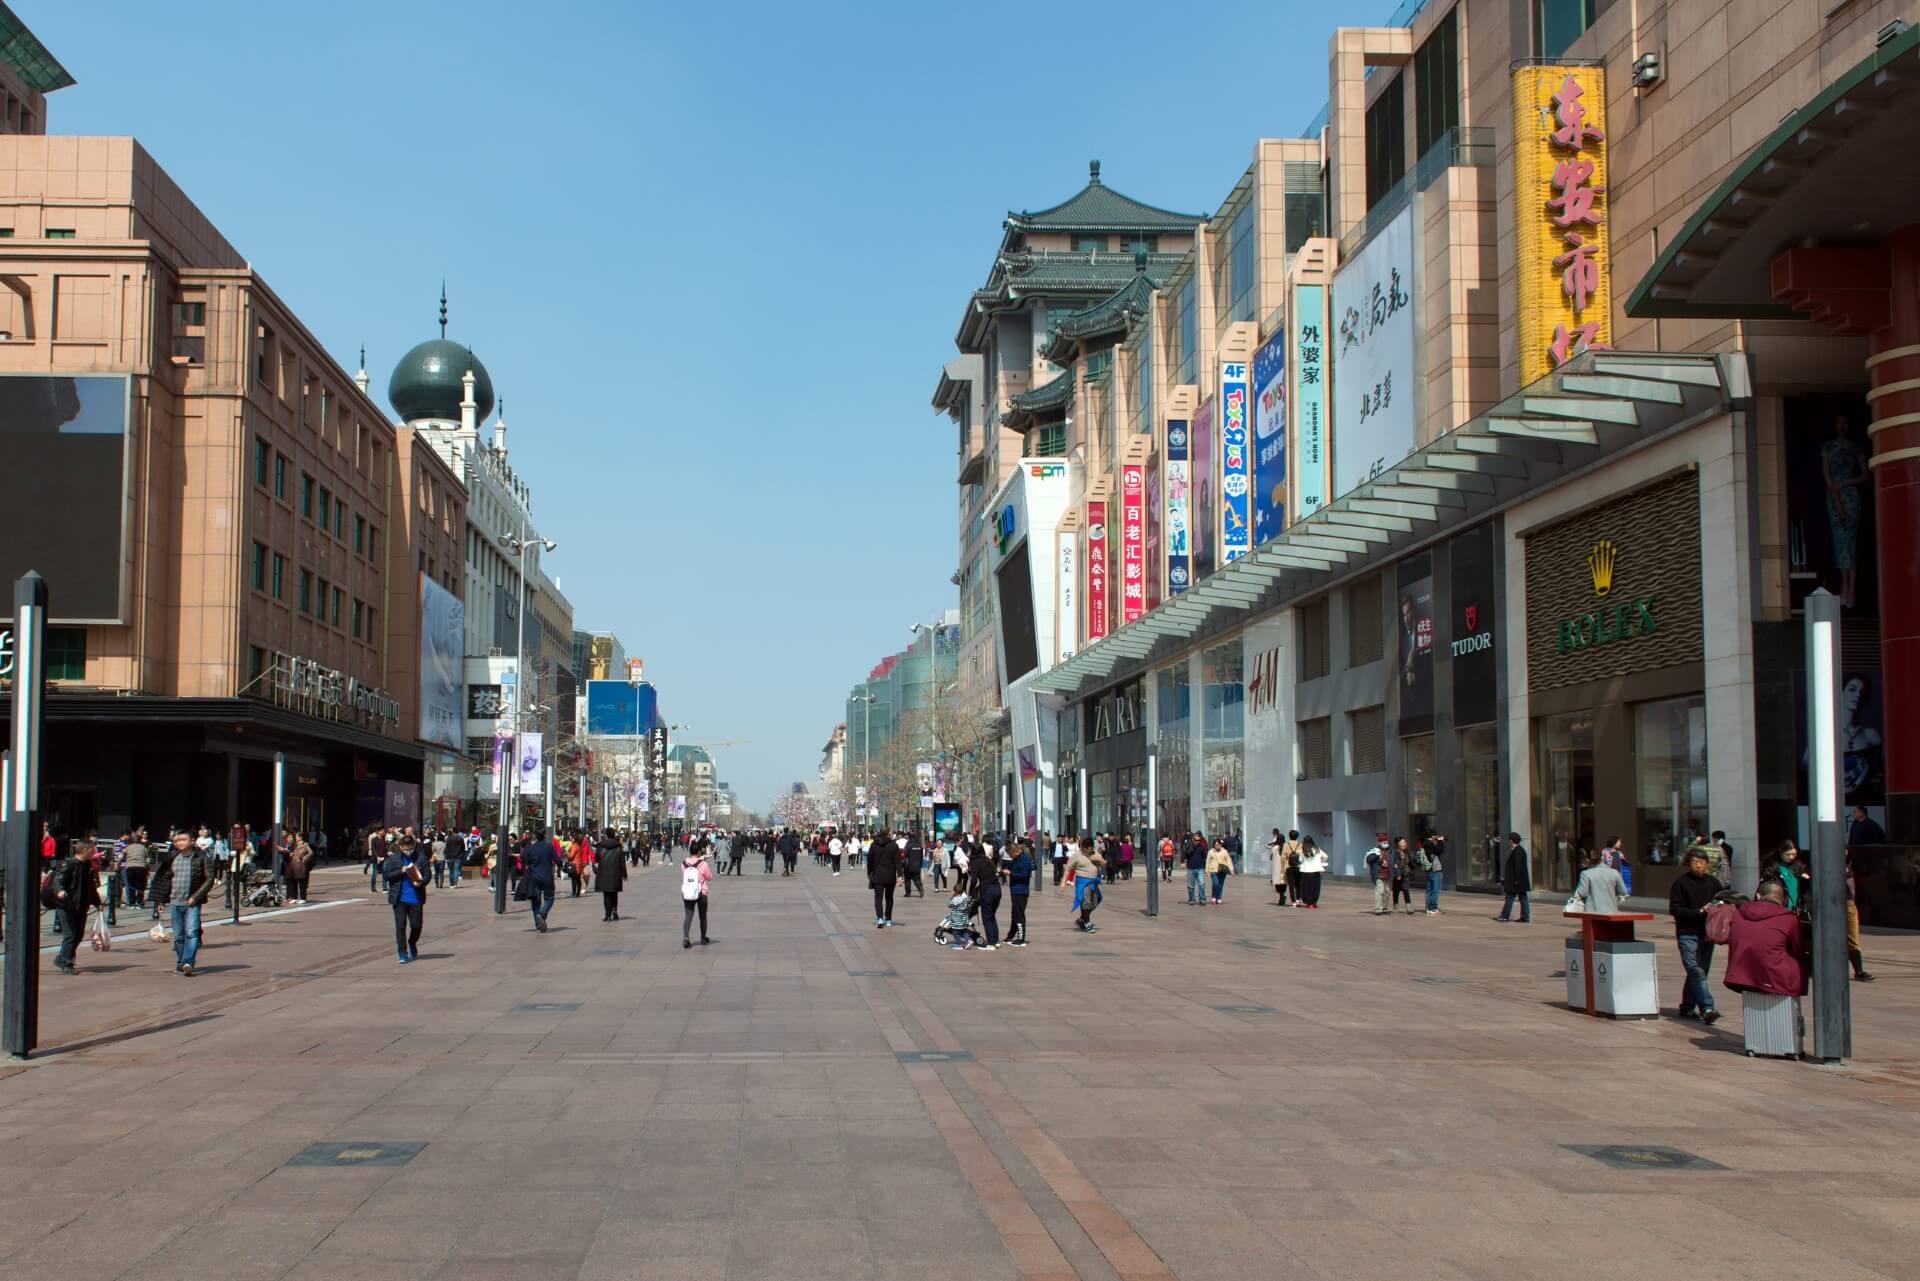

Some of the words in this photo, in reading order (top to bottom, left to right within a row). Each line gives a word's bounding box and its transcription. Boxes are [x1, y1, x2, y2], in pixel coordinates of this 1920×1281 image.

[1224, 364, 1246, 378] 4F
[1302, 325, 1320, 385] 外婆家
[1031, 466, 1065, 480] apm
[1369, 457, 1385, 480] 6F
[1305, 497, 1319, 505] 6F
[1125, 506, 1142, 598] 百老汇影城
[1557, 596, 1657, 653] ROLEX
[1452, 632, 1492, 656] TUDOR
[1250, 647, 1279, 715] H&M
[348, 676, 400, 728] Wangfujing
[474, 690, 499, 714] 药
[1095, 695, 1135, 741] ZARA
